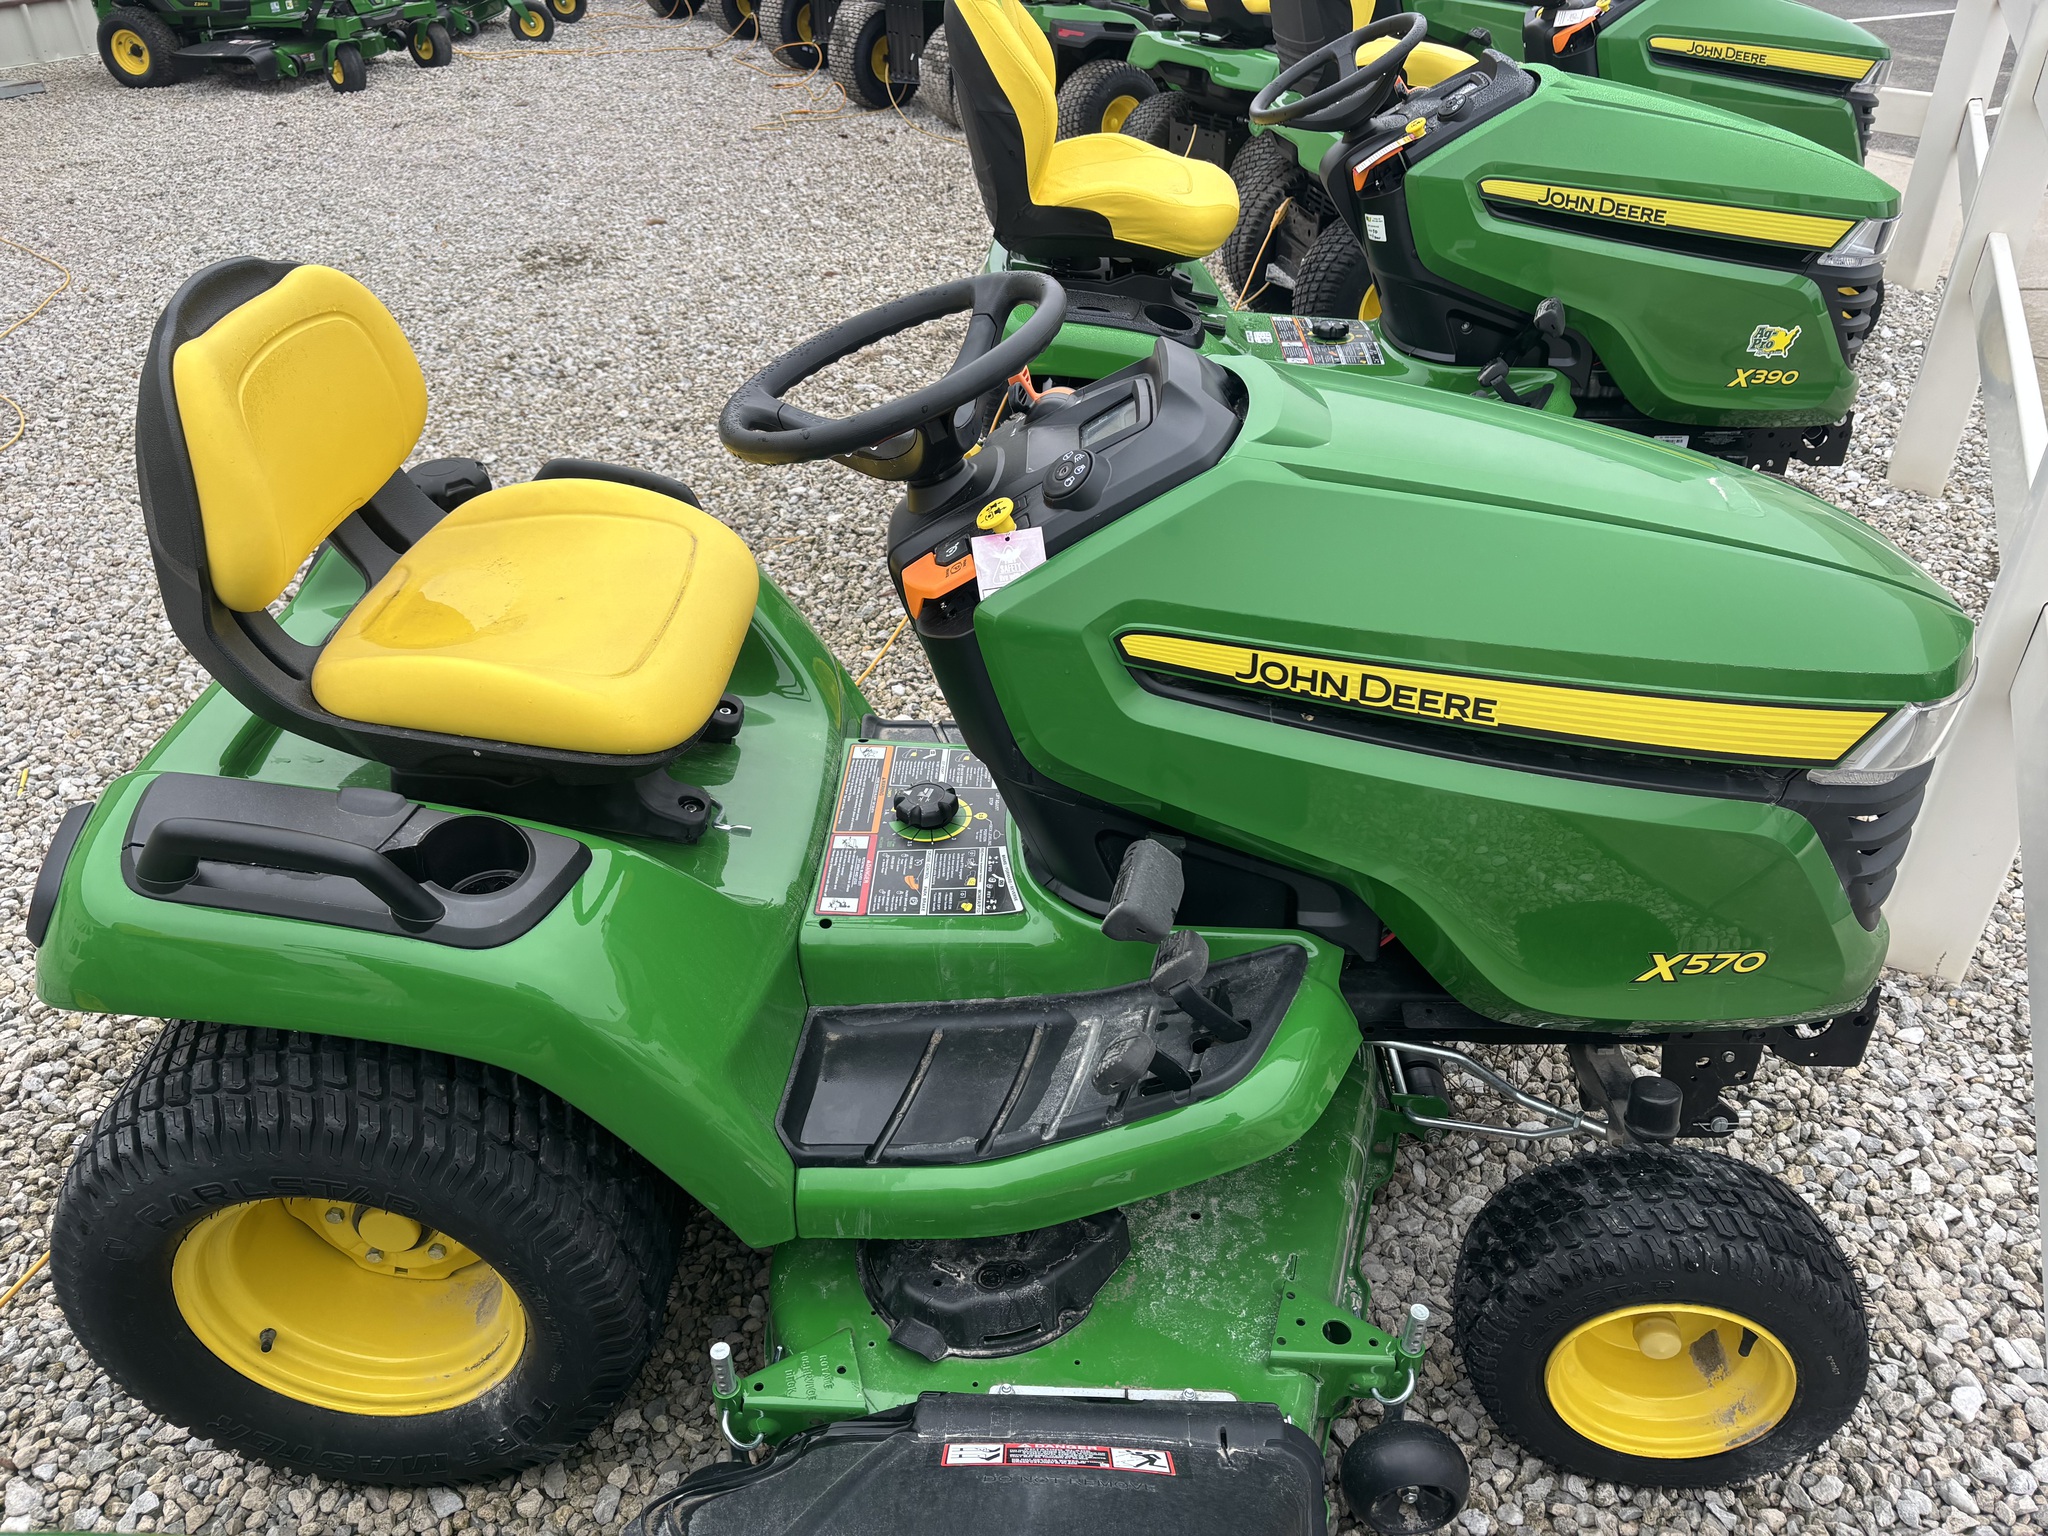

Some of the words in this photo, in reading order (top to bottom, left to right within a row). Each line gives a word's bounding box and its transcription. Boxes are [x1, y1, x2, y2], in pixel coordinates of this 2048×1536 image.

[1686, 41, 1723, 58] JOHN
[1725, 47, 1767, 64] DEERE
[1537, 187, 1595, 212] JOHN
[1599, 197, 1667, 224] DEERE
[1750, 338, 1775, 349] Pro
[1726, 368, 1800, 388] X390
[1000, 563, 1022, 573] SAFETY
[1235, 652, 1349, 702] JOHN
[1358, 672, 1498, 723] DEERE
[864, 864, 872, 883] DANGER
[1631, 951, 1769, 982] X570
[1521, 1279, 1676, 1350] CARLSTAR
[462, 1395, 561, 1467] TURF
[204, 1415, 450, 1477] MASTER
[983, 1474, 1013, 1483] DO
[1020, 1476, 1060, 1484] NOT
[1069, 1478, 1157, 1493] REMOVE
